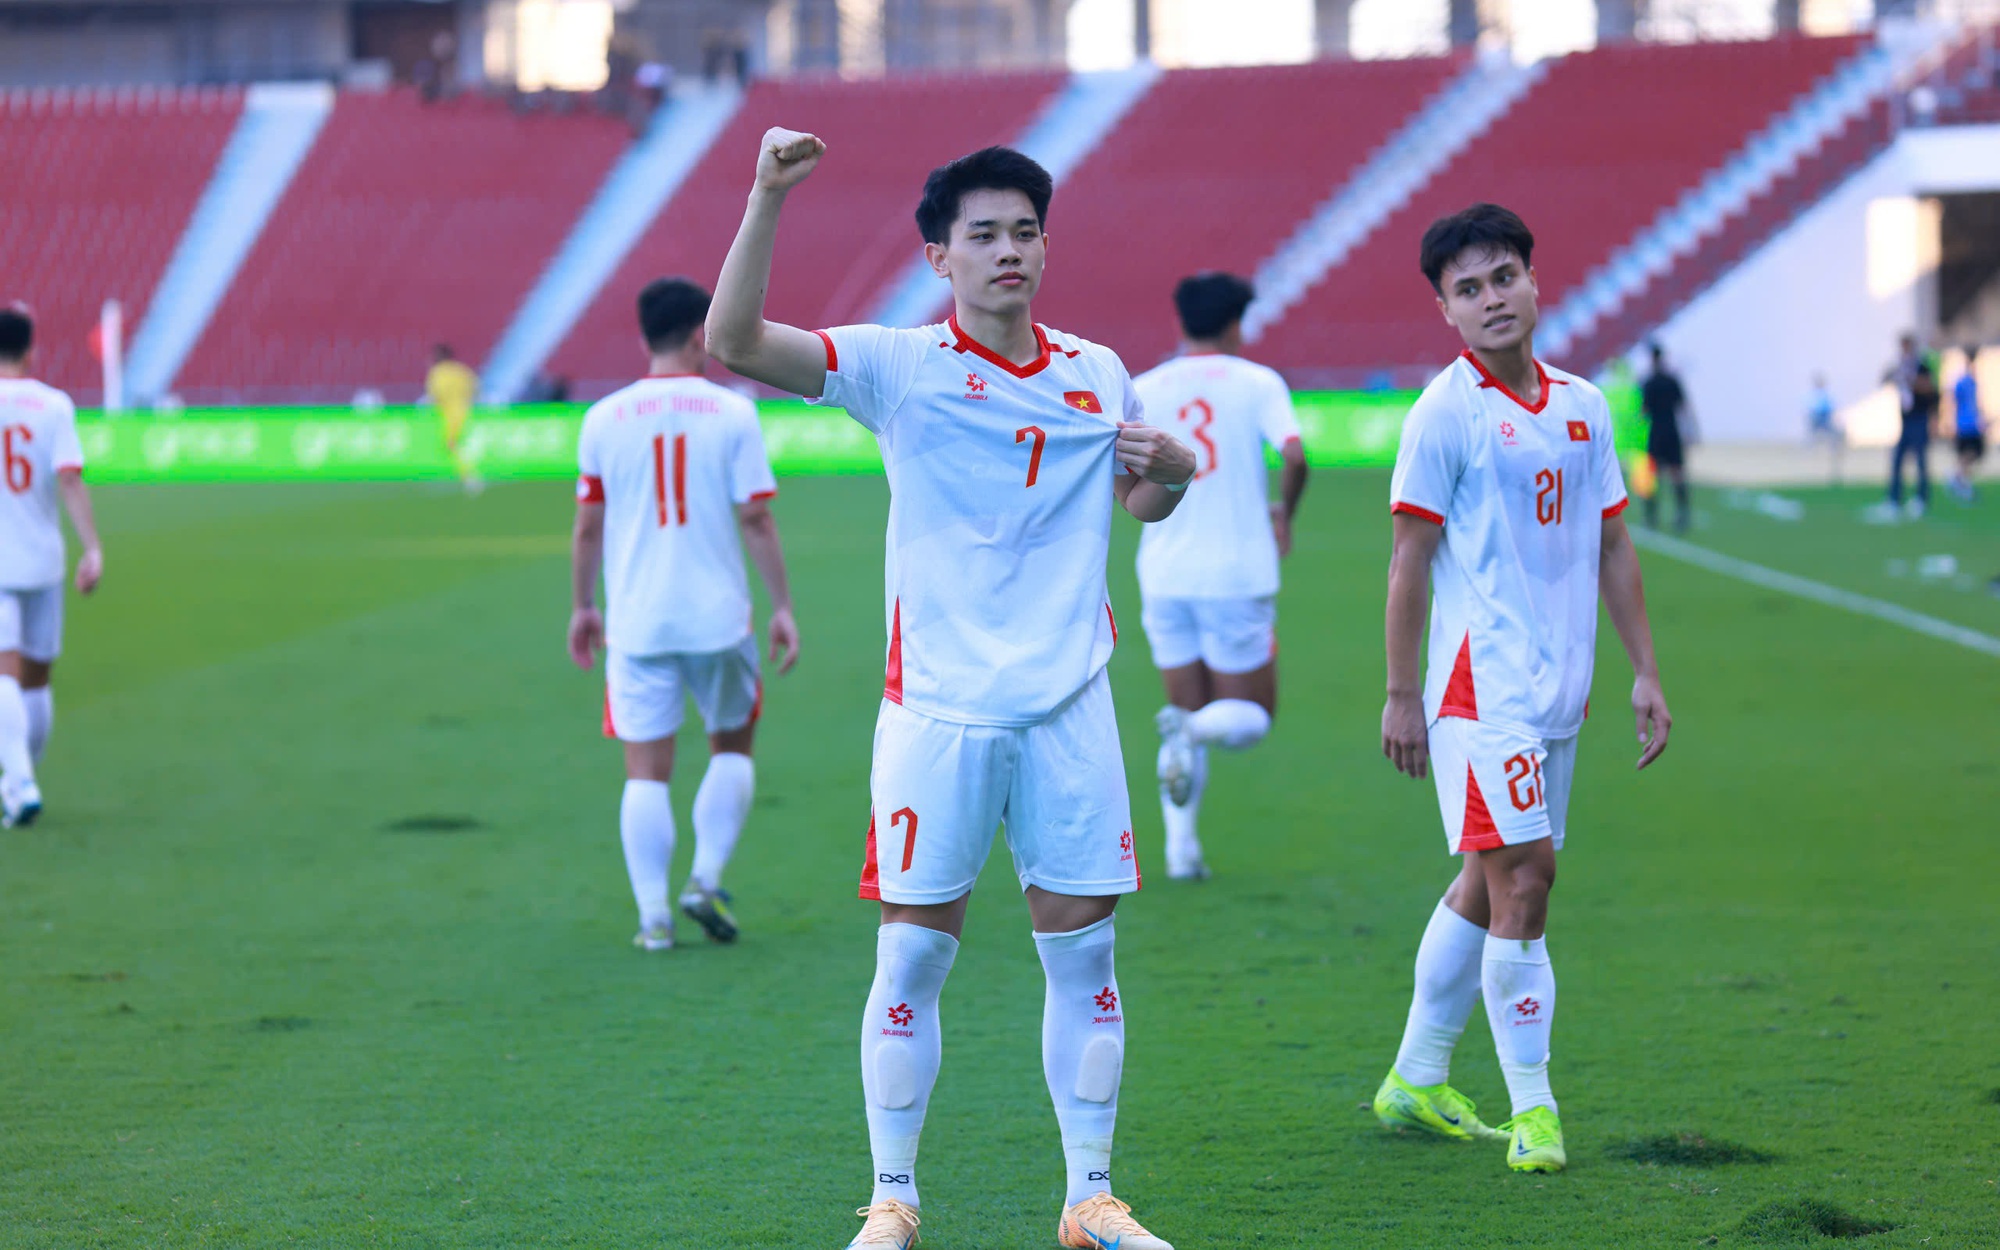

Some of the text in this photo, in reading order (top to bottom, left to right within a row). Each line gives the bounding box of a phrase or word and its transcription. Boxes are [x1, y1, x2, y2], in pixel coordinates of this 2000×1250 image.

[3, 423, 33, 495] 6
[652, 431, 689, 528] 11
[1015, 425, 1047, 488] 7
[1535, 467, 1563, 526] 21
[1504, 752, 1543, 812] 21
[890, 806, 918, 873] 7
